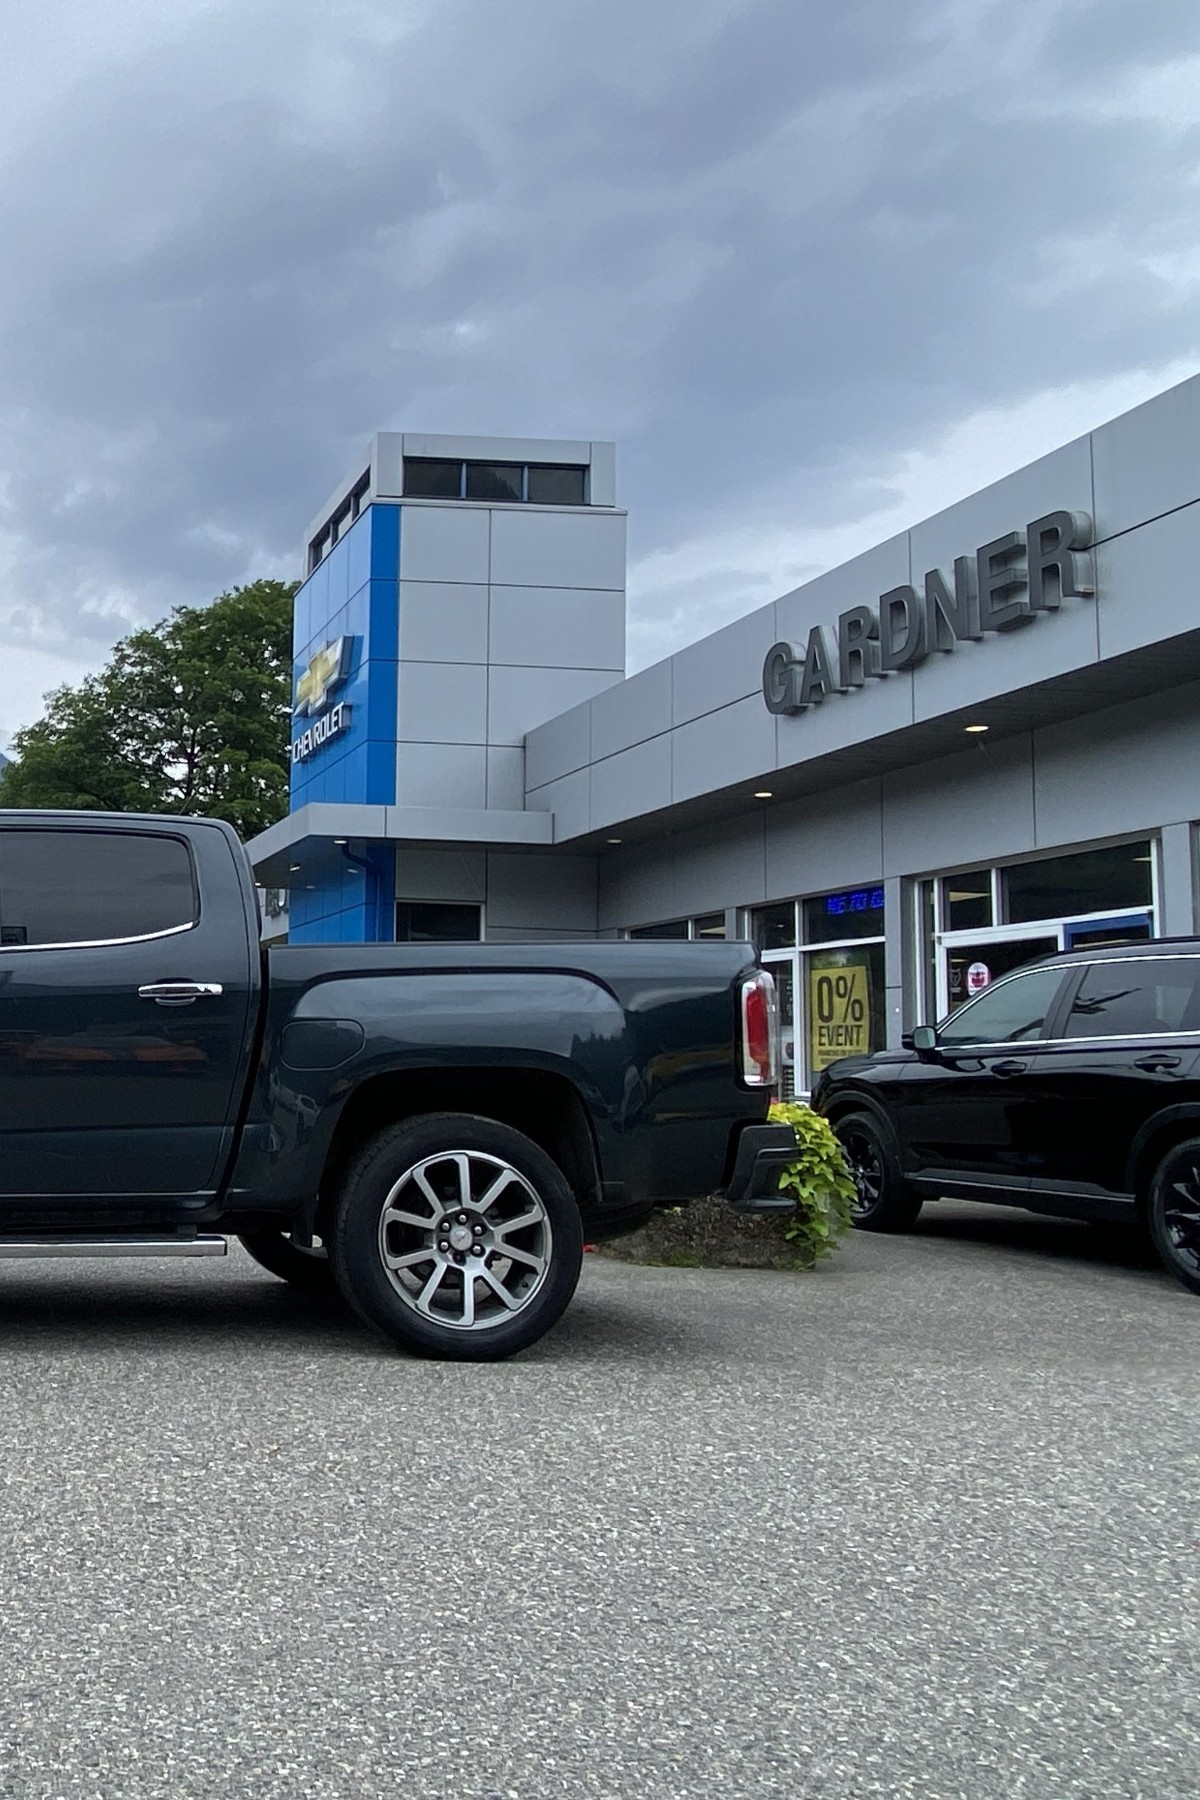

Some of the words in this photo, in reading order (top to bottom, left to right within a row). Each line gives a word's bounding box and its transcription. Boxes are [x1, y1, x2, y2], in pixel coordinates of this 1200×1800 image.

[762, 510, 1094, 716] GARDNER
[292, 701, 347, 763] CHEVROLET
[817, 973, 864, 1023] 0%
[818, 1024, 863, 1047] EVENT
